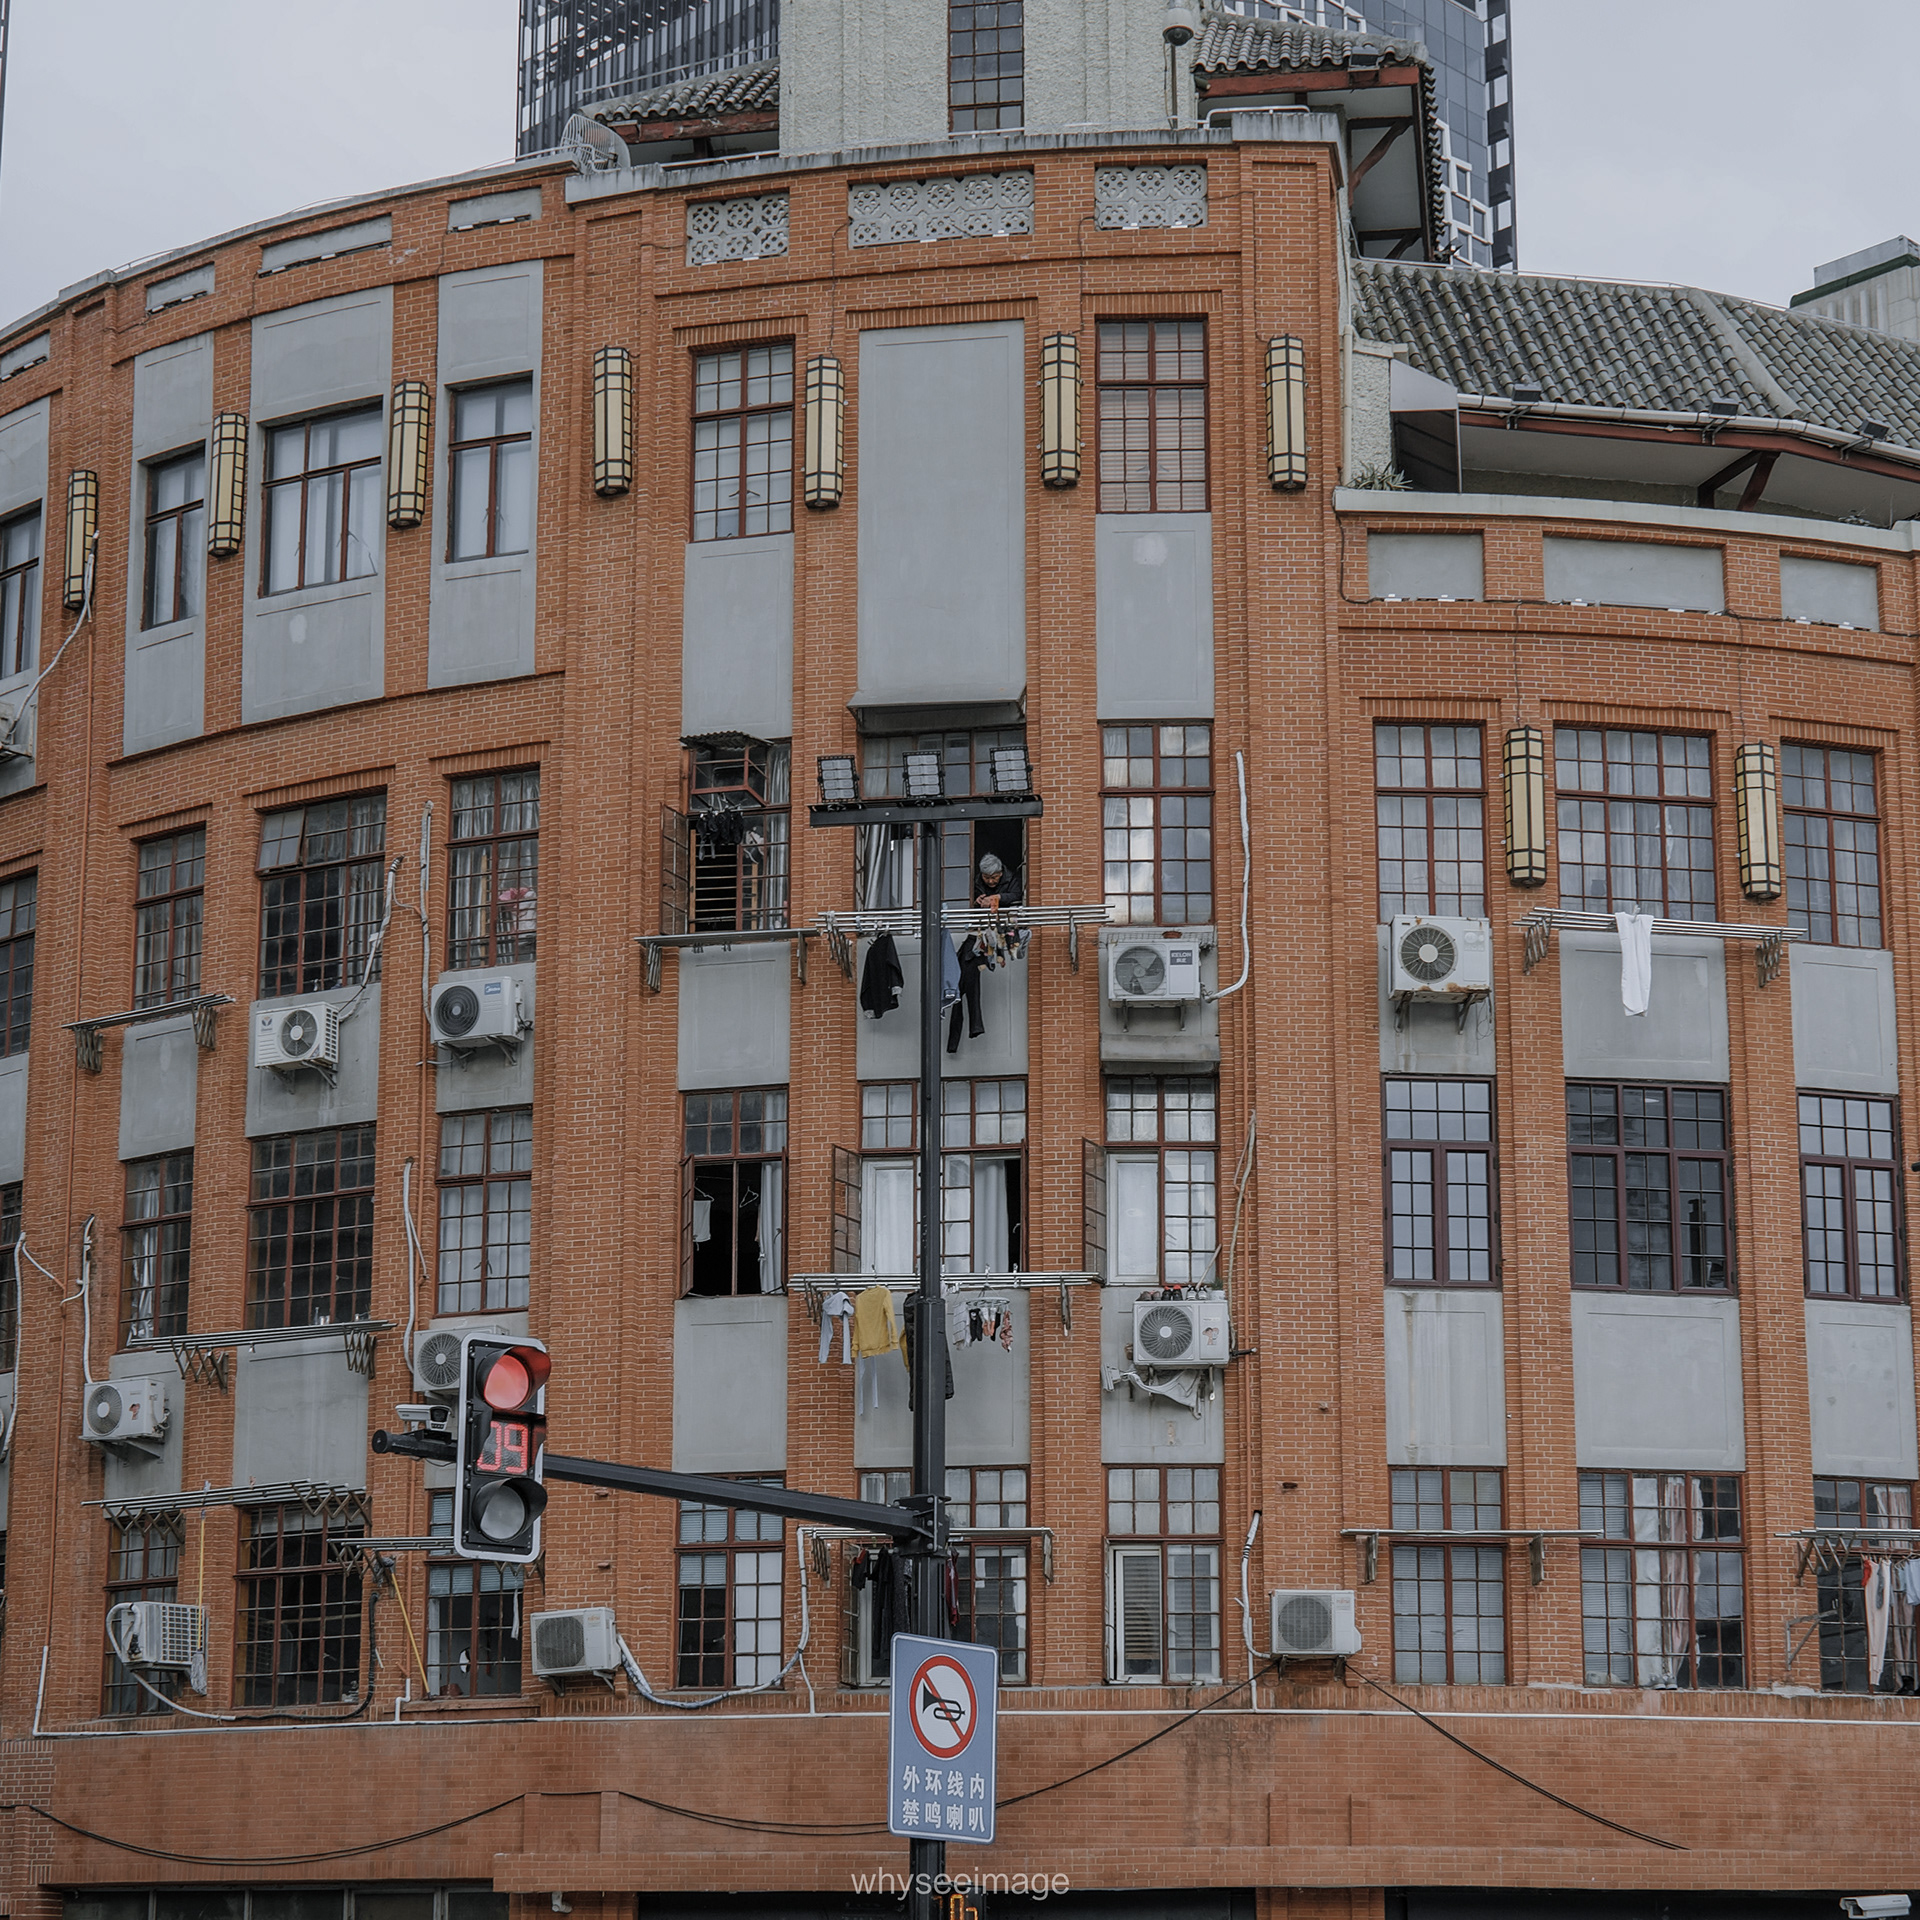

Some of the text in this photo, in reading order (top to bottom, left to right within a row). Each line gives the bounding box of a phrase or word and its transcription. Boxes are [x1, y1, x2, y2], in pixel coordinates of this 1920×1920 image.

[903, 1765, 985, 1800] 外环线内
[902, 1798, 985, 1832] 禁鸣喇叭
